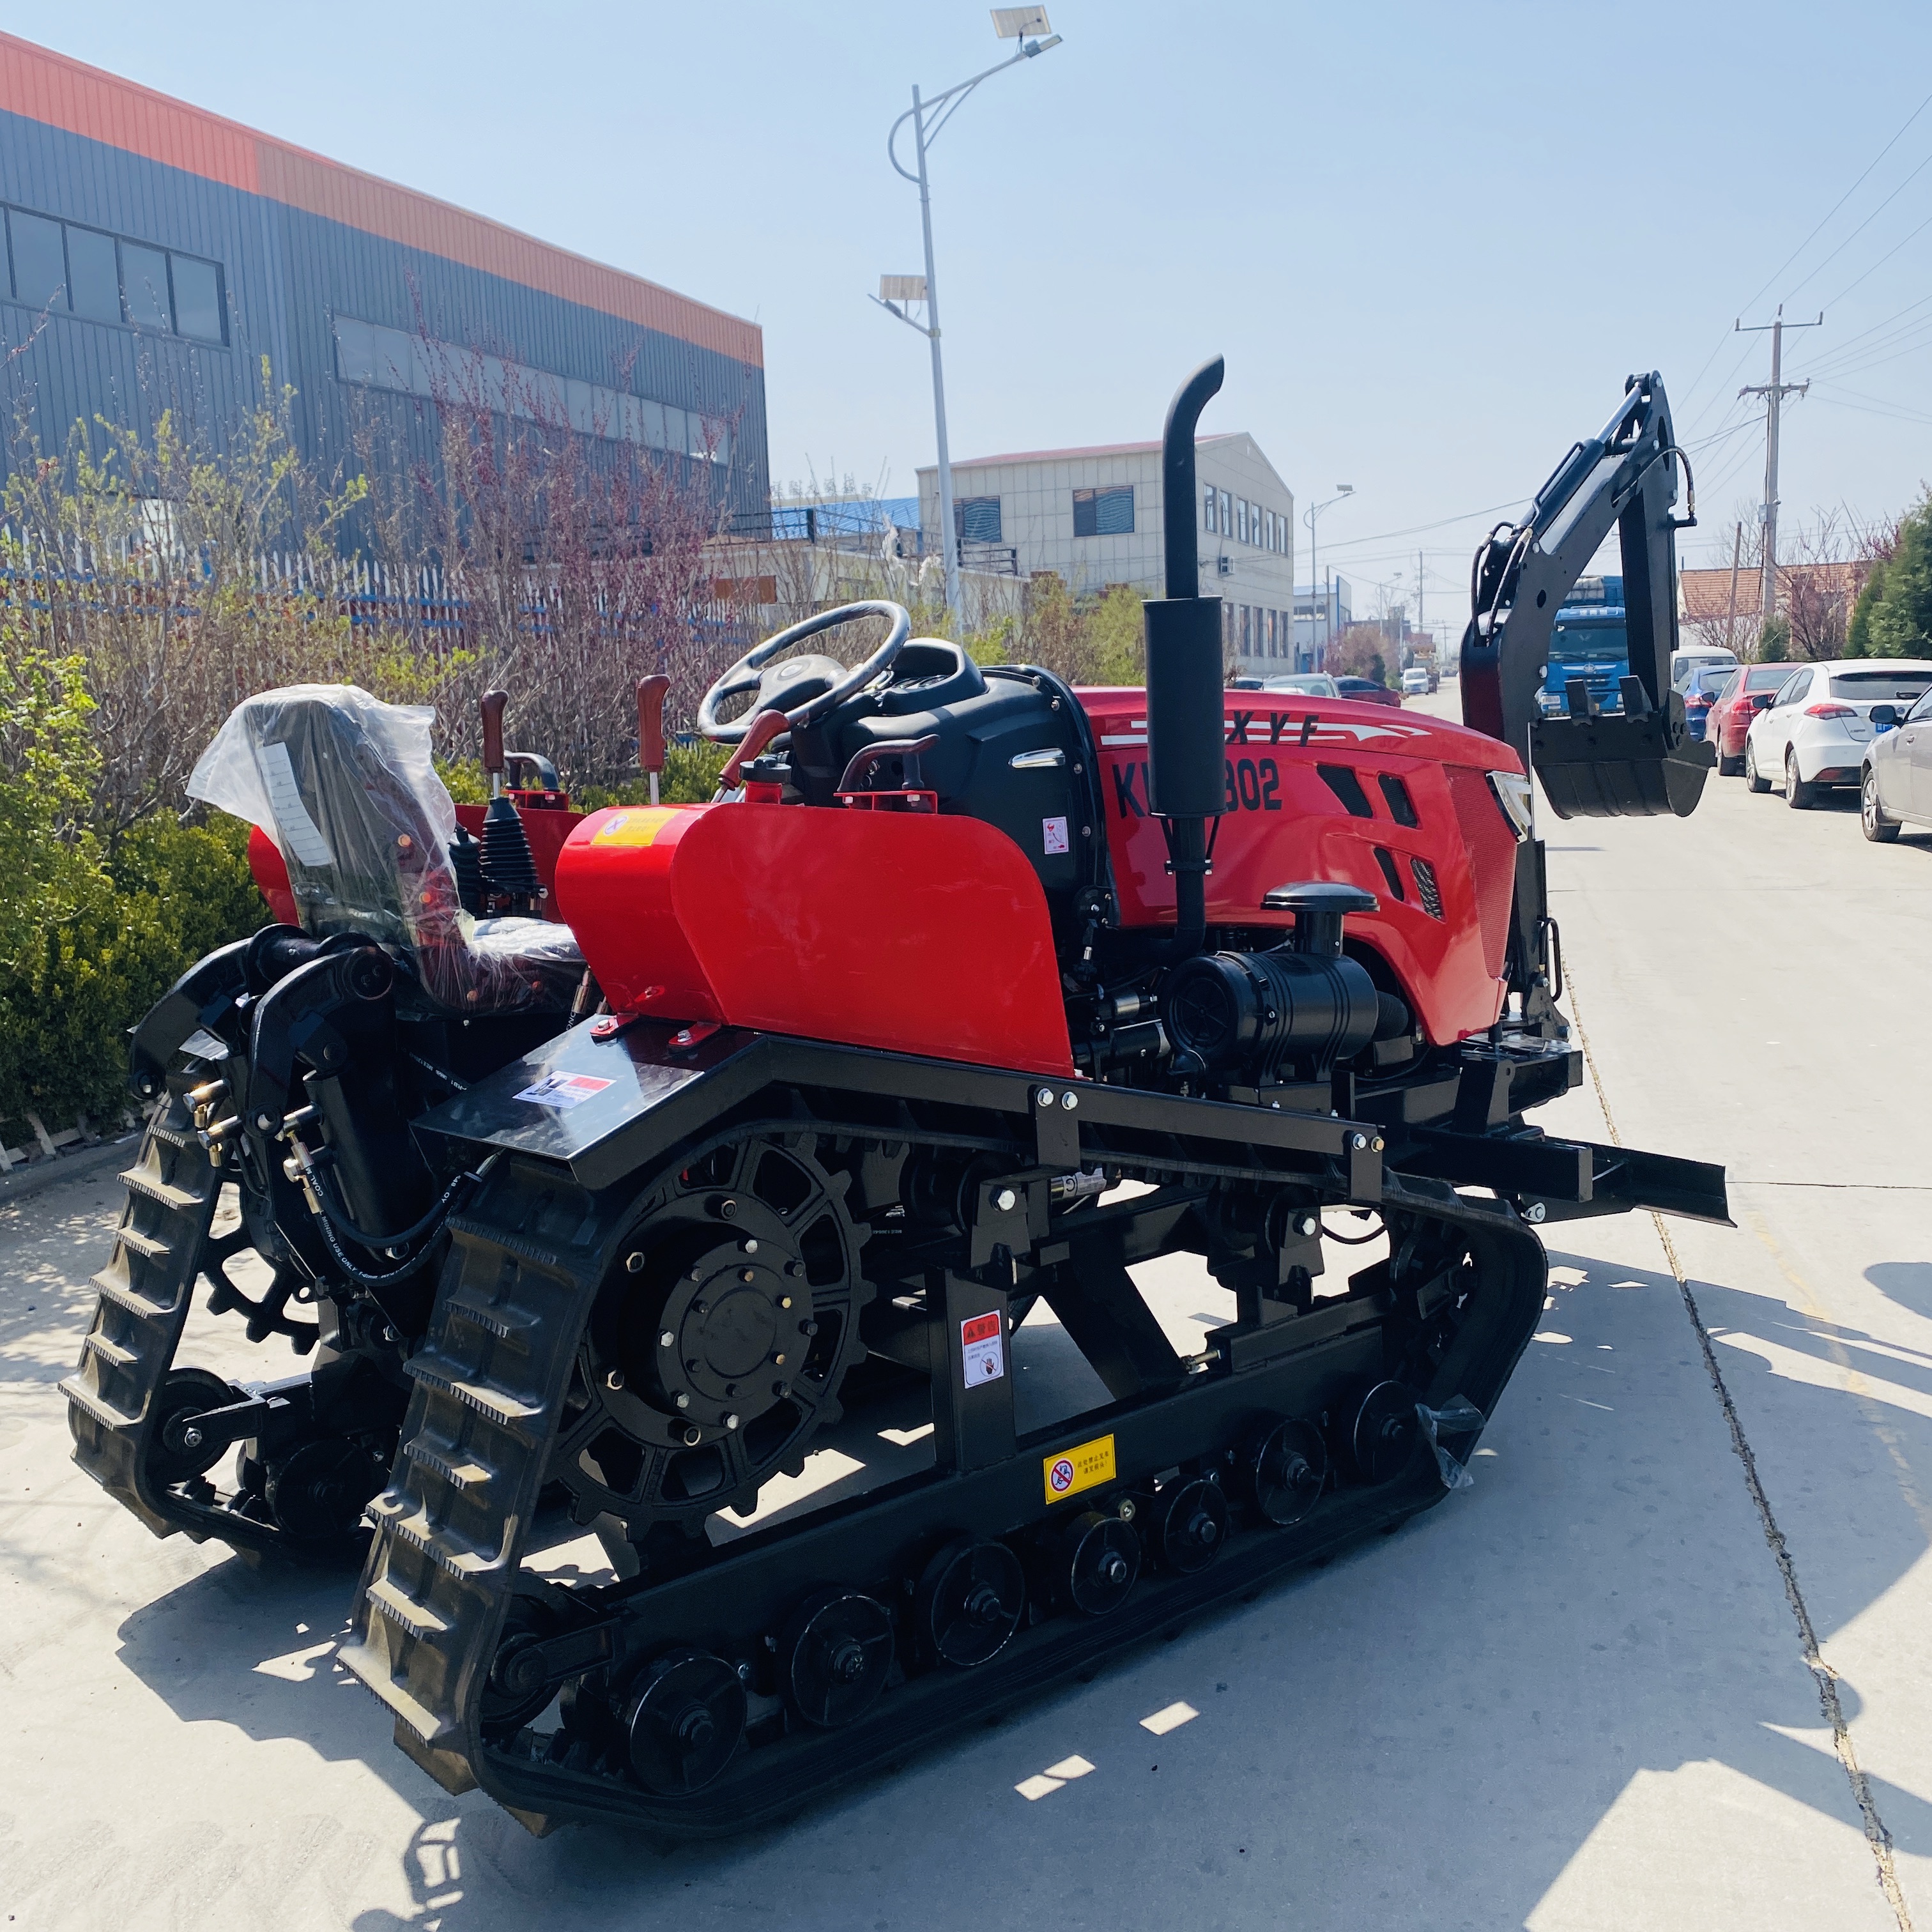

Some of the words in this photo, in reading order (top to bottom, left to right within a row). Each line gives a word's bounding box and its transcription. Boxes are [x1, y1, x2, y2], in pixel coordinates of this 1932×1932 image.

[310, 1175, 324, 1197] COAL
[321, 1216, 336, 1243] MINING
[333, 1243, 344, 1257] USE
[341, 1257, 358, 1271] ONLY
